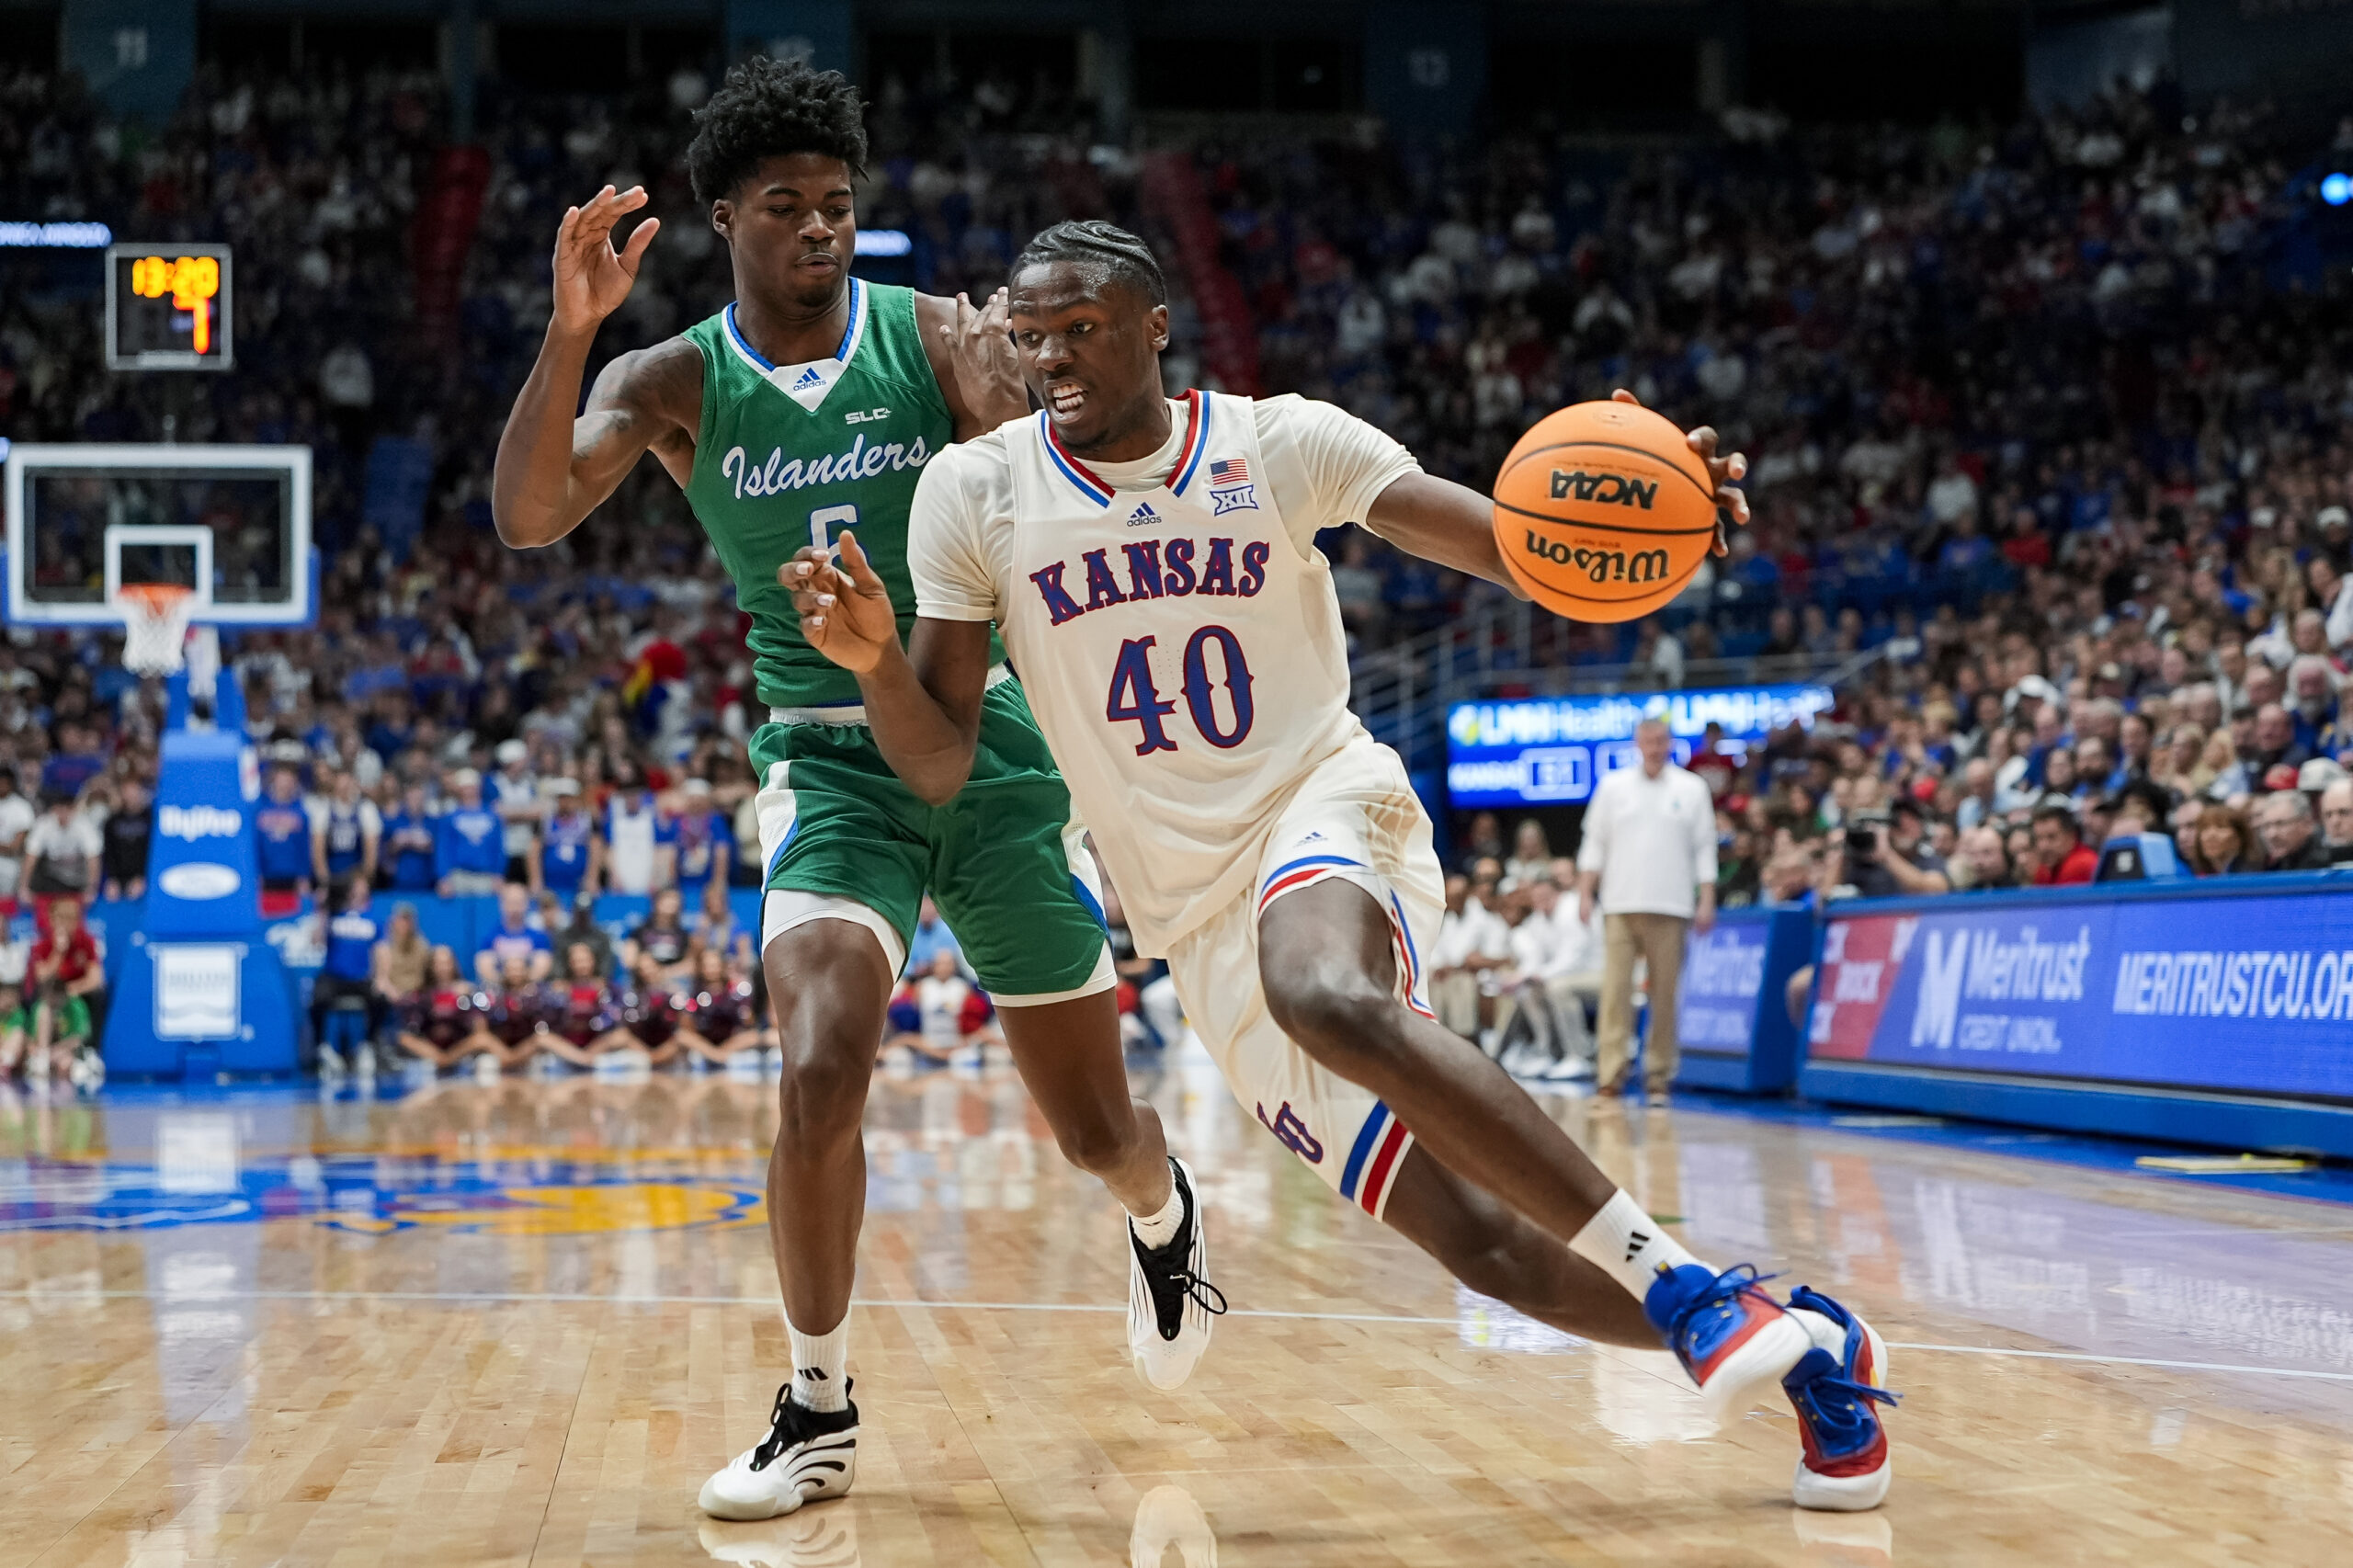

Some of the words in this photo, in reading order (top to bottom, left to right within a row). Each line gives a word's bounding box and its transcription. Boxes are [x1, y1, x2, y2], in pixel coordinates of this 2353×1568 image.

[792, 379, 827, 392] adidas
[845, 407, 892, 425] SLC
[722, 433, 932, 500] Islanders
[1214, 490, 1253, 511] XII
[1550, 470, 1658, 510] NCAA
[1126, 515, 1162, 528] adidas
[1526, 528, 1670, 584] Wilson
[1029, 538, 1270, 627] KANSAS
[1106, 624, 1255, 757] 40
